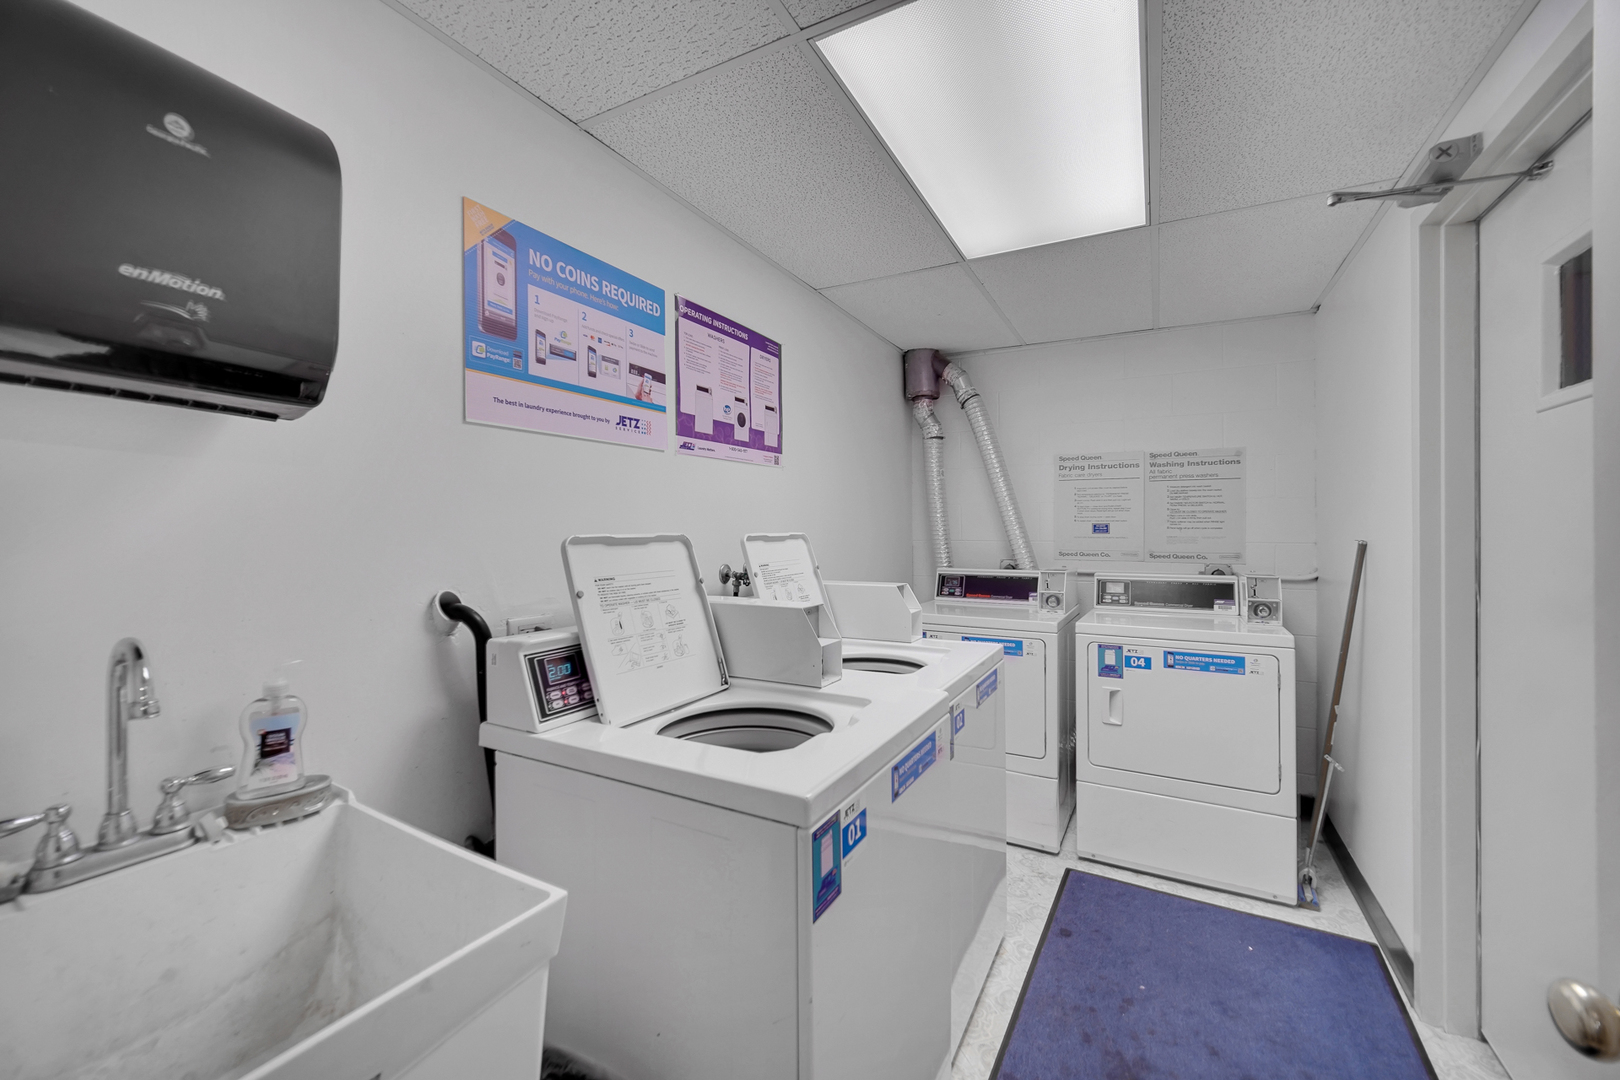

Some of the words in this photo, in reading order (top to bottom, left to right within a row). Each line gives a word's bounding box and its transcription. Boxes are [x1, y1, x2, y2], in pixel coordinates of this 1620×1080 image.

[529, 249, 553, 272] NO
[556, 261, 599, 292] COINS
[602, 280, 661, 317] REQUIRED
[529, 269, 542, 281] Pay
[542, 274, 555, 286] with
[555, 281, 569, 292] your
[569, 286, 589, 299] phone.
[590, 294, 606, 306] Here's
[534, 295, 540, 305] 1
[581, 311, 587, 321] 2
[680, 305, 712, 324] OPERATING
[713, 319, 748, 340] INSTRUCTIONS
[629, 328, 634, 338] 3
[707, 332, 725, 344] WASHERS
[486, 345, 509, 356] Download
[486, 352, 511, 364] PayRange
[493, 396, 504, 404] The
[505, 399, 517, 407] best
[524, 402, 545, 413] laundry
[545, 406, 572, 418] experience
[572, 411, 591, 421] brought
[596, 416, 605, 424] you
[605, 417, 610, 425] by
[615, 415, 640, 430] JETZ
[1149, 451, 1172, 459] Speed
[1173, 450, 1198, 458] Queen
[1058, 464, 1085, 472] Drying
[1087, 462, 1140, 470] Instructions
[1149, 460, 1185, 468] Washing
[1187, 458, 1241, 467] Instructions
[1130, 657, 1146, 667] 04
[1184, 655, 1212, 663] QUARTERS
[548, 662, 571, 678] 2.00
[847, 818, 861, 846] 01
